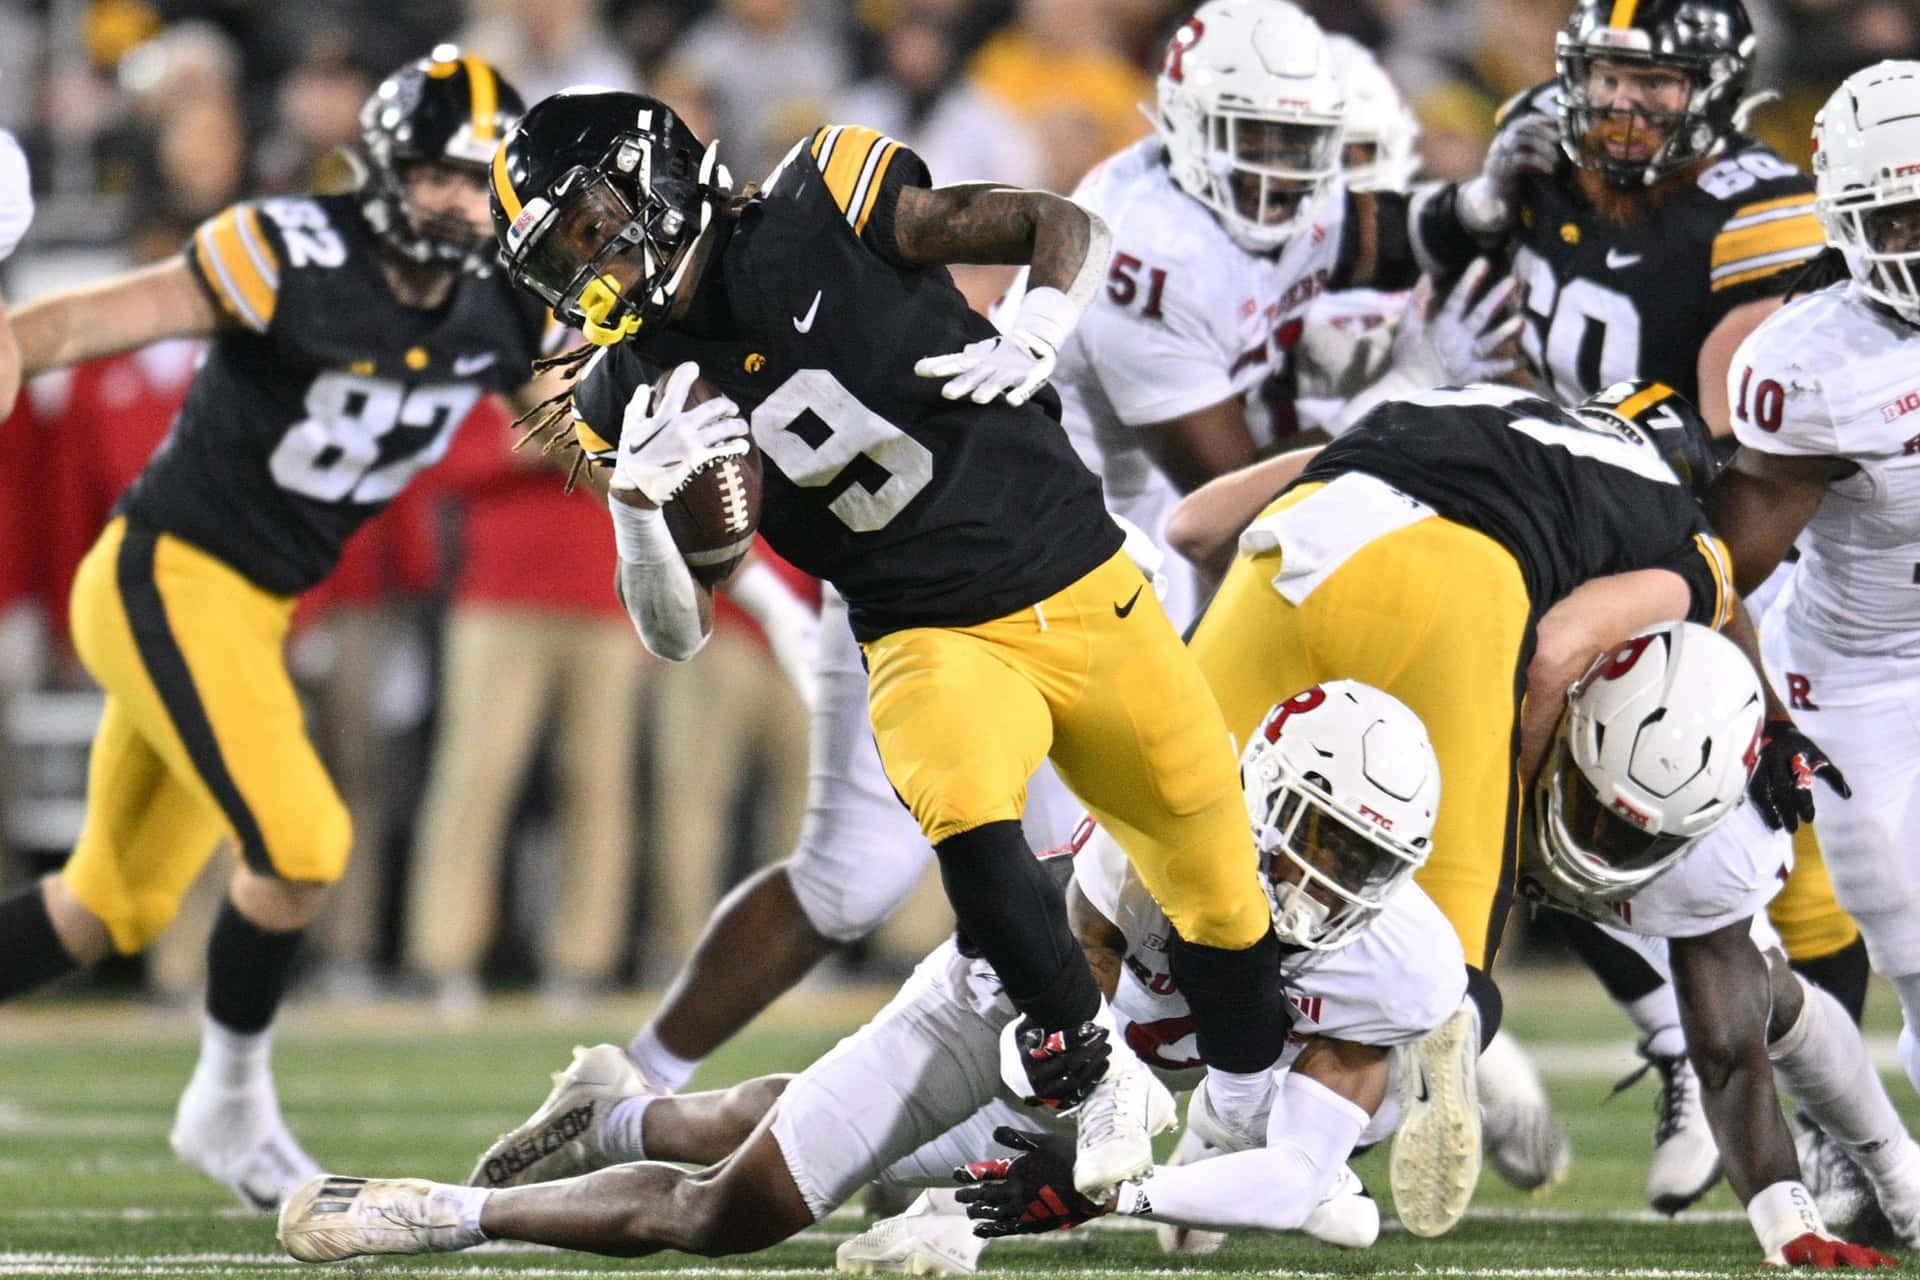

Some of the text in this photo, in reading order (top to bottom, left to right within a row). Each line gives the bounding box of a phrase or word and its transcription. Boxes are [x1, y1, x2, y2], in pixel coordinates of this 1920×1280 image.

[1107, 252, 1167, 321] 51
[1736, 365, 1785, 433] 10
[751, 369, 933, 533] 9
[1785, 672, 1820, 711] R
[1358, 804, 1394, 832] FTC
